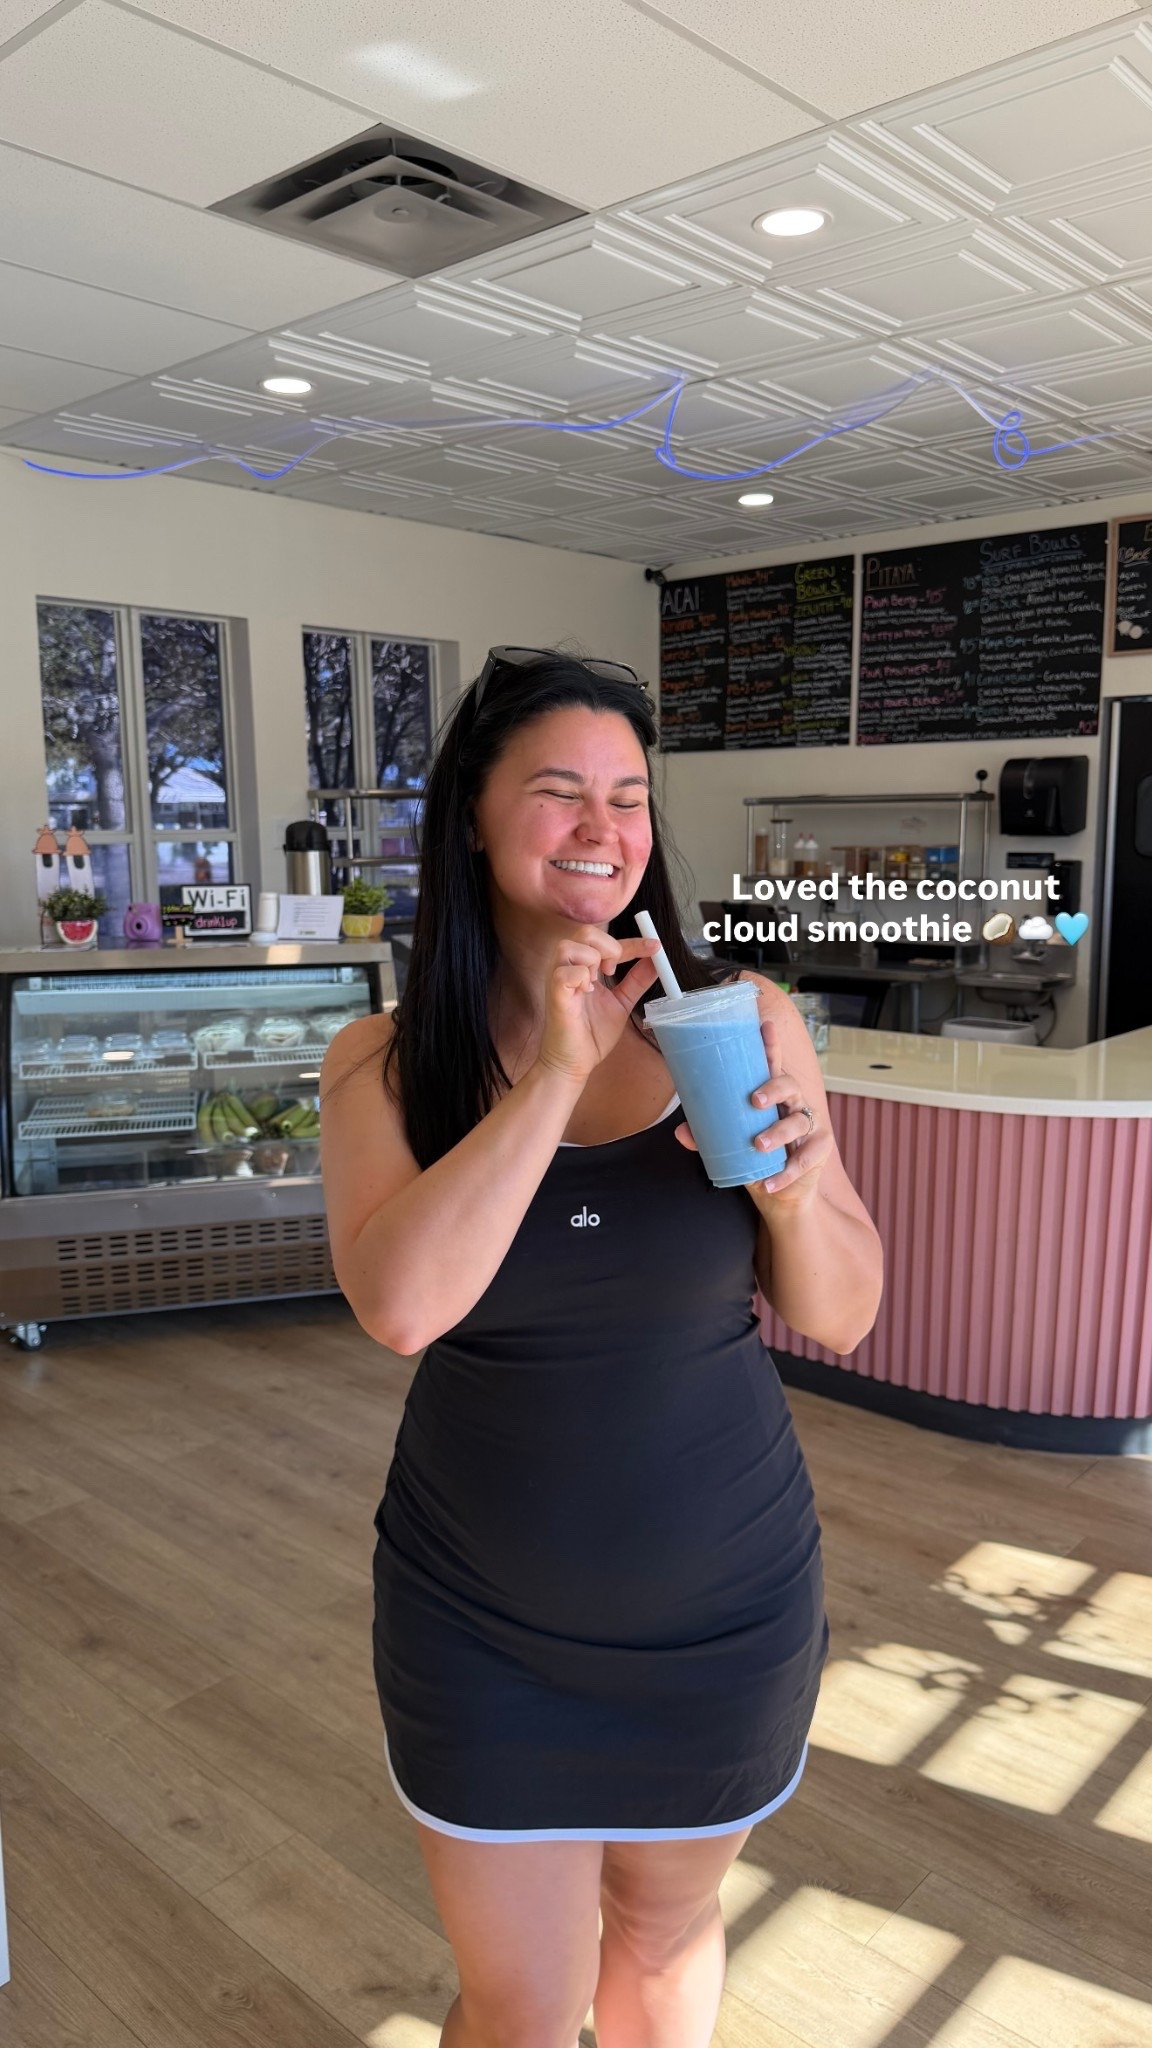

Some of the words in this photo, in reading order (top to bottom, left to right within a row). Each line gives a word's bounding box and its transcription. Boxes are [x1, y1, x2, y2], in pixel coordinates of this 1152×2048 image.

[795, 564, 836, 584] GREEN
[866, 557, 916, 590] PITAYA
[796, 579, 840, 600] BOWLS
[188, 889, 245, 909] Wi-Fi
[570, 1206, 601, 1228] alo
